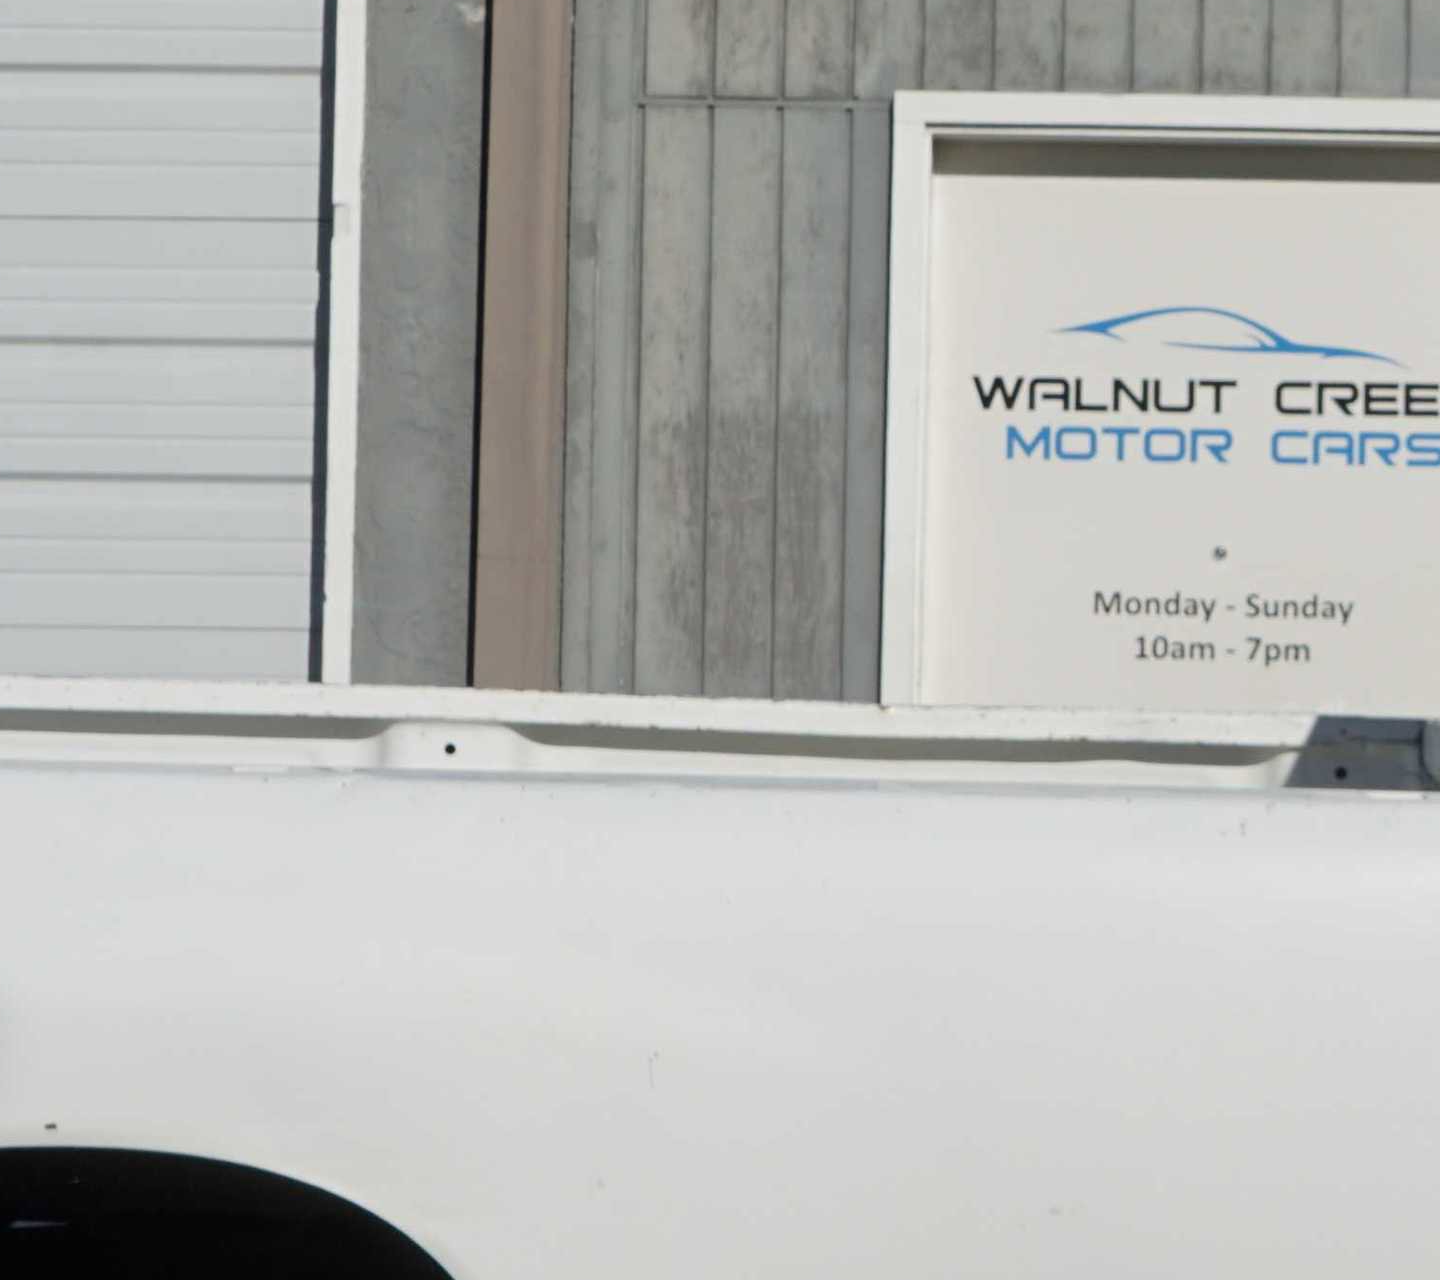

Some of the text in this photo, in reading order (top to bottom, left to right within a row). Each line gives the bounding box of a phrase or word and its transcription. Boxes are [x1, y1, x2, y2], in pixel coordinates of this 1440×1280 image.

[972, 375, 1239, 415] WALNUT
[1005, 424, 1234, 464] MOTOR
[1092, 589, 1217, 624] Monday
[1244, 592, 1355, 626] Sunday
[1134, 634, 1216, 661] 10am
[1246, 635, 1312, 668] 7pm
